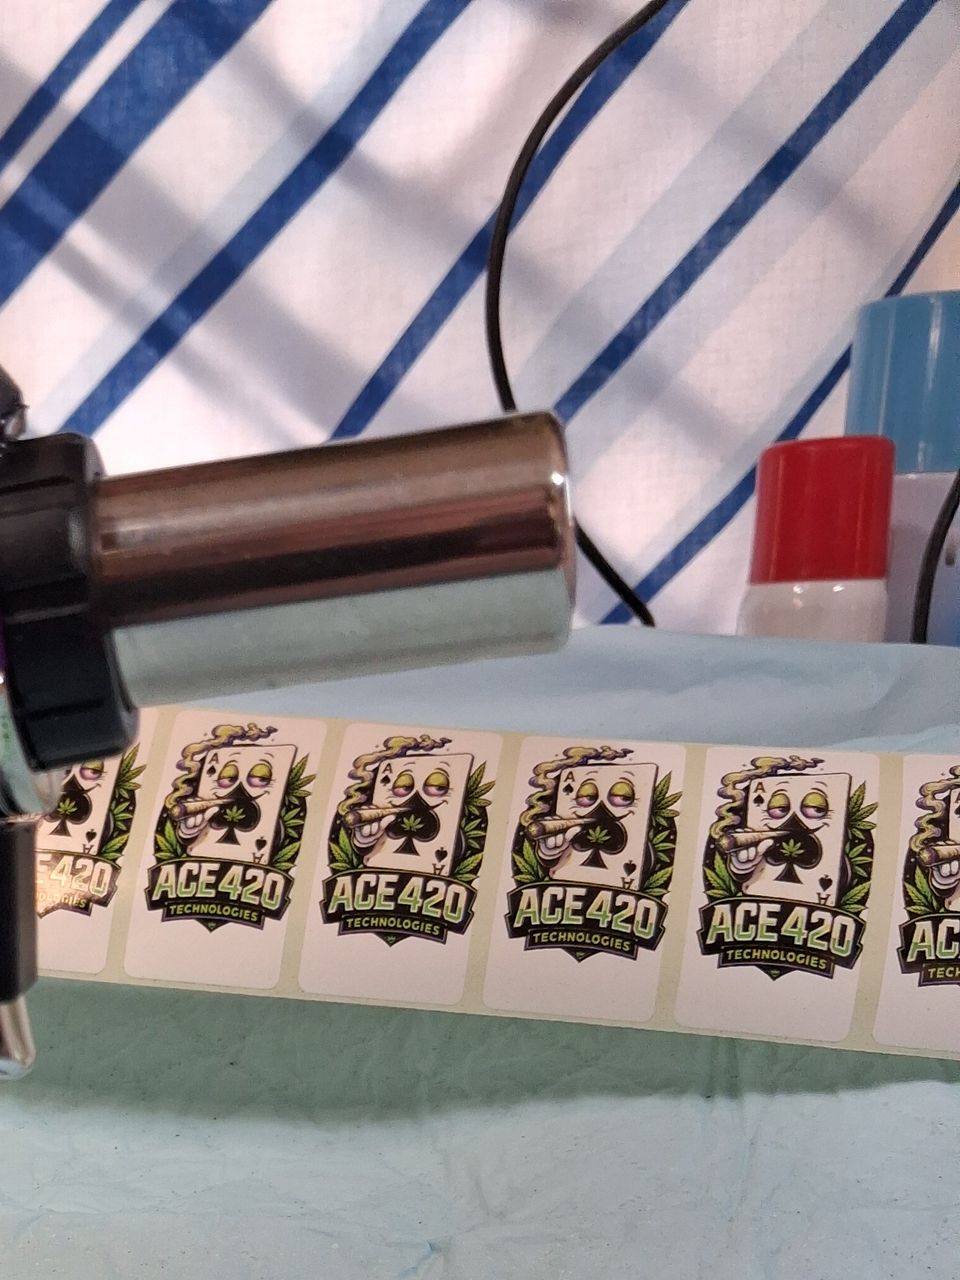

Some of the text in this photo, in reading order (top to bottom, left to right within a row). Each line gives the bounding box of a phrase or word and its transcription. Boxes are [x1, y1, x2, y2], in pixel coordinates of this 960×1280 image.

[208, 753, 220, 765] A
[382, 763, 394, 775] A
[564, 771, 576, 783] A
[753, 781, 766, 793] A
[151, 862, 285, 911] ACE 420
[328, 873, 468, 924] ACE 420
[169, 903, 258, 922] TECHNOLOGIES
[513, 886, 658, 939] ACE 420
[346, 917, 441, 936] TECHNOLOGIES
[706, 902, 856, 957] ACE 420
[533, 932, 632, 952] TECHNOLOGIES
[906, 919, 960, 962] AC
[727, 949, 827, 969] TECHNOLOGIES
